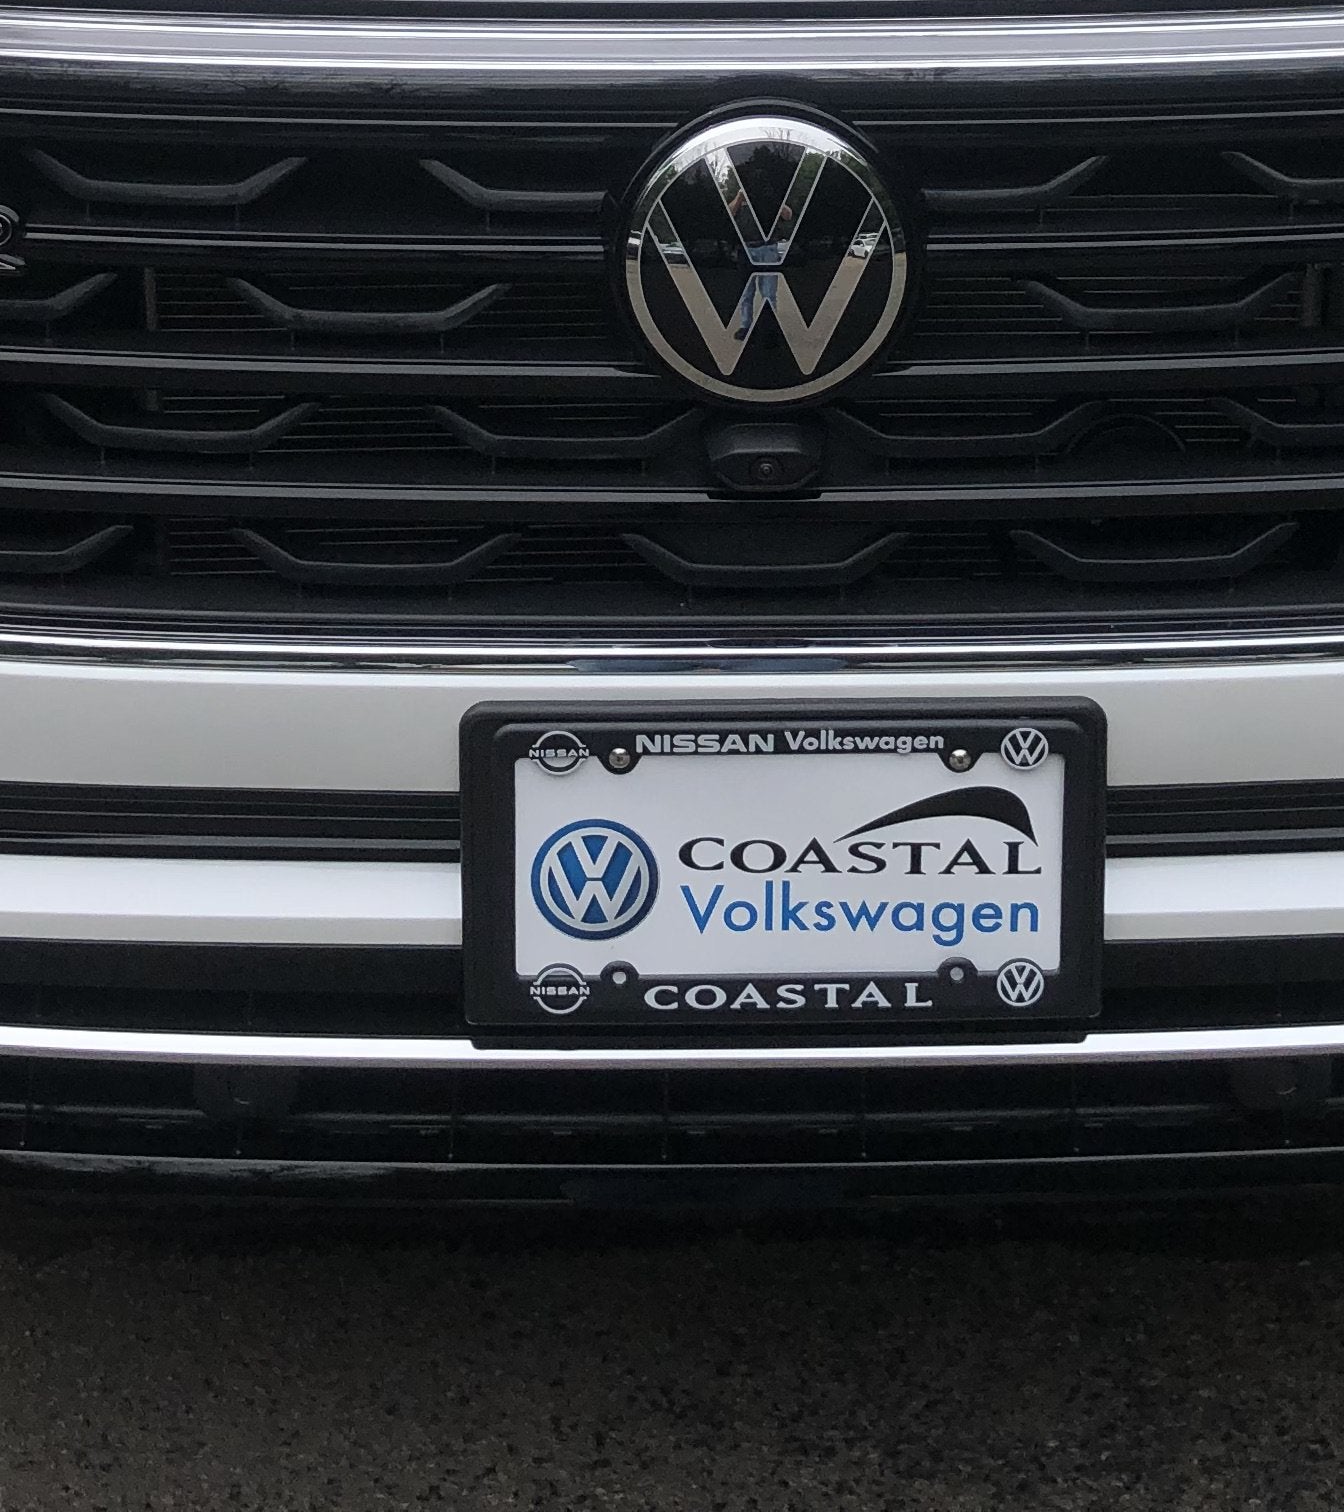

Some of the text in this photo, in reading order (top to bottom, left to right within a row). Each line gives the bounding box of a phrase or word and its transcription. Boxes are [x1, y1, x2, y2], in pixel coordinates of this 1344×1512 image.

[529, 748, 589, 758] NISSAN
[636, 730, 945, 754] NISSAN Volkswagen
[678, 836, 1042, 875] COASTAL
[680, 881, 1039, 946] Volkswagen
[529, 986, 590, 996] NISSAN
[643, 981, 933, 1010] COASTAL
